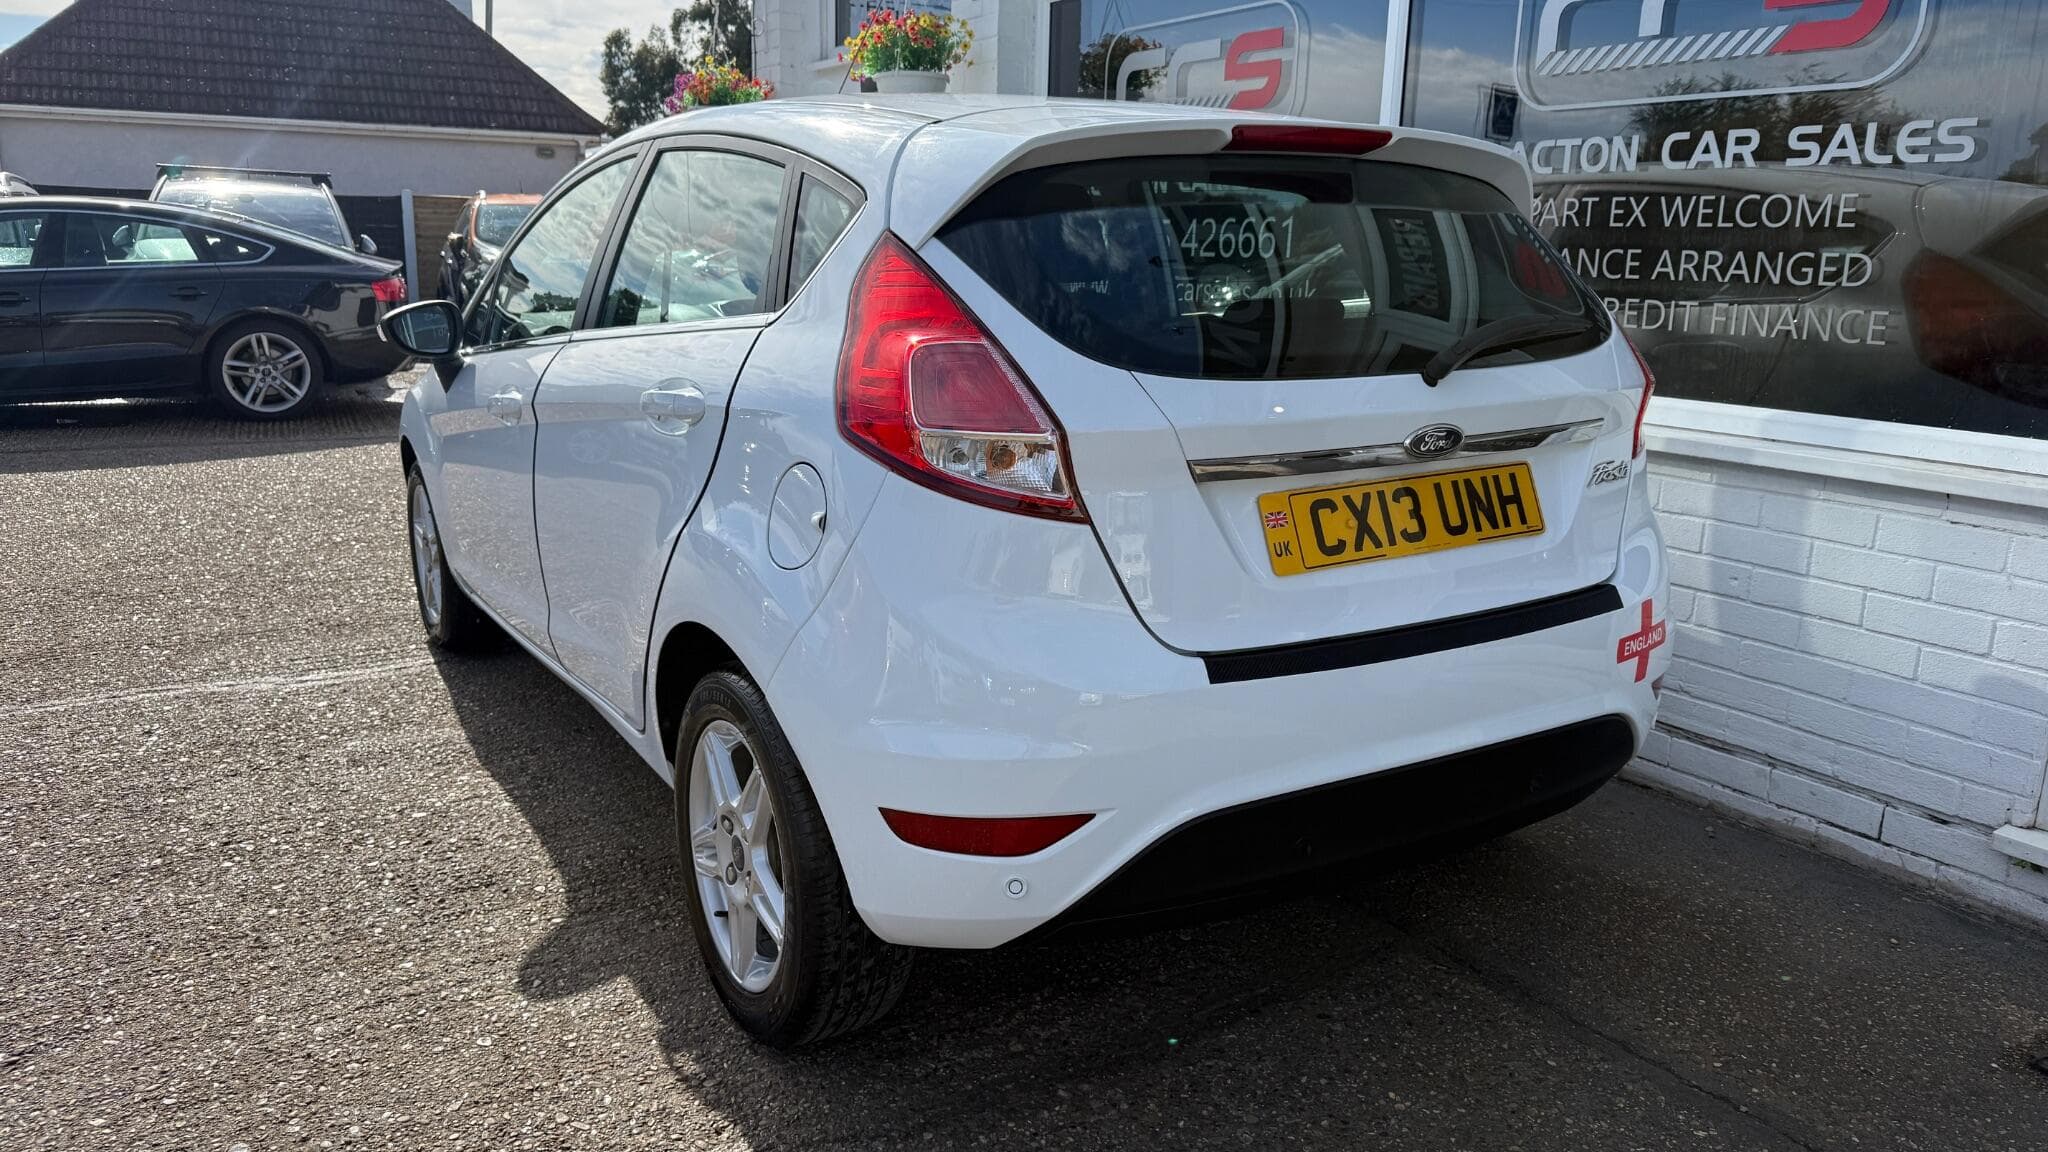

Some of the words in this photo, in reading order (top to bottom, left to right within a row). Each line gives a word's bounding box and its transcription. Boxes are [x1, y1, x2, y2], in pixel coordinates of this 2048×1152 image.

[1661, 128, 1760, 169] CAR
[1785, 117, 1980, 167] SALES
[1609, 196, 1650, 227] EX
[1660, 193, 1860, 228] WELCOME
[1180, 215, 1294, 258] 426661
[1651, 249, 1873, 288] ARRANGED
[1710, 301, 1890, 345] FINANCE
[1421, 431, 1455, 452] Ford
[1309, 487, 1428, 557] CX13
[1433, 472, 1528, 537] UNH
[1273, 540, 1293, 558] UK
[1624, 627, 1663, 656] ENGLAND
